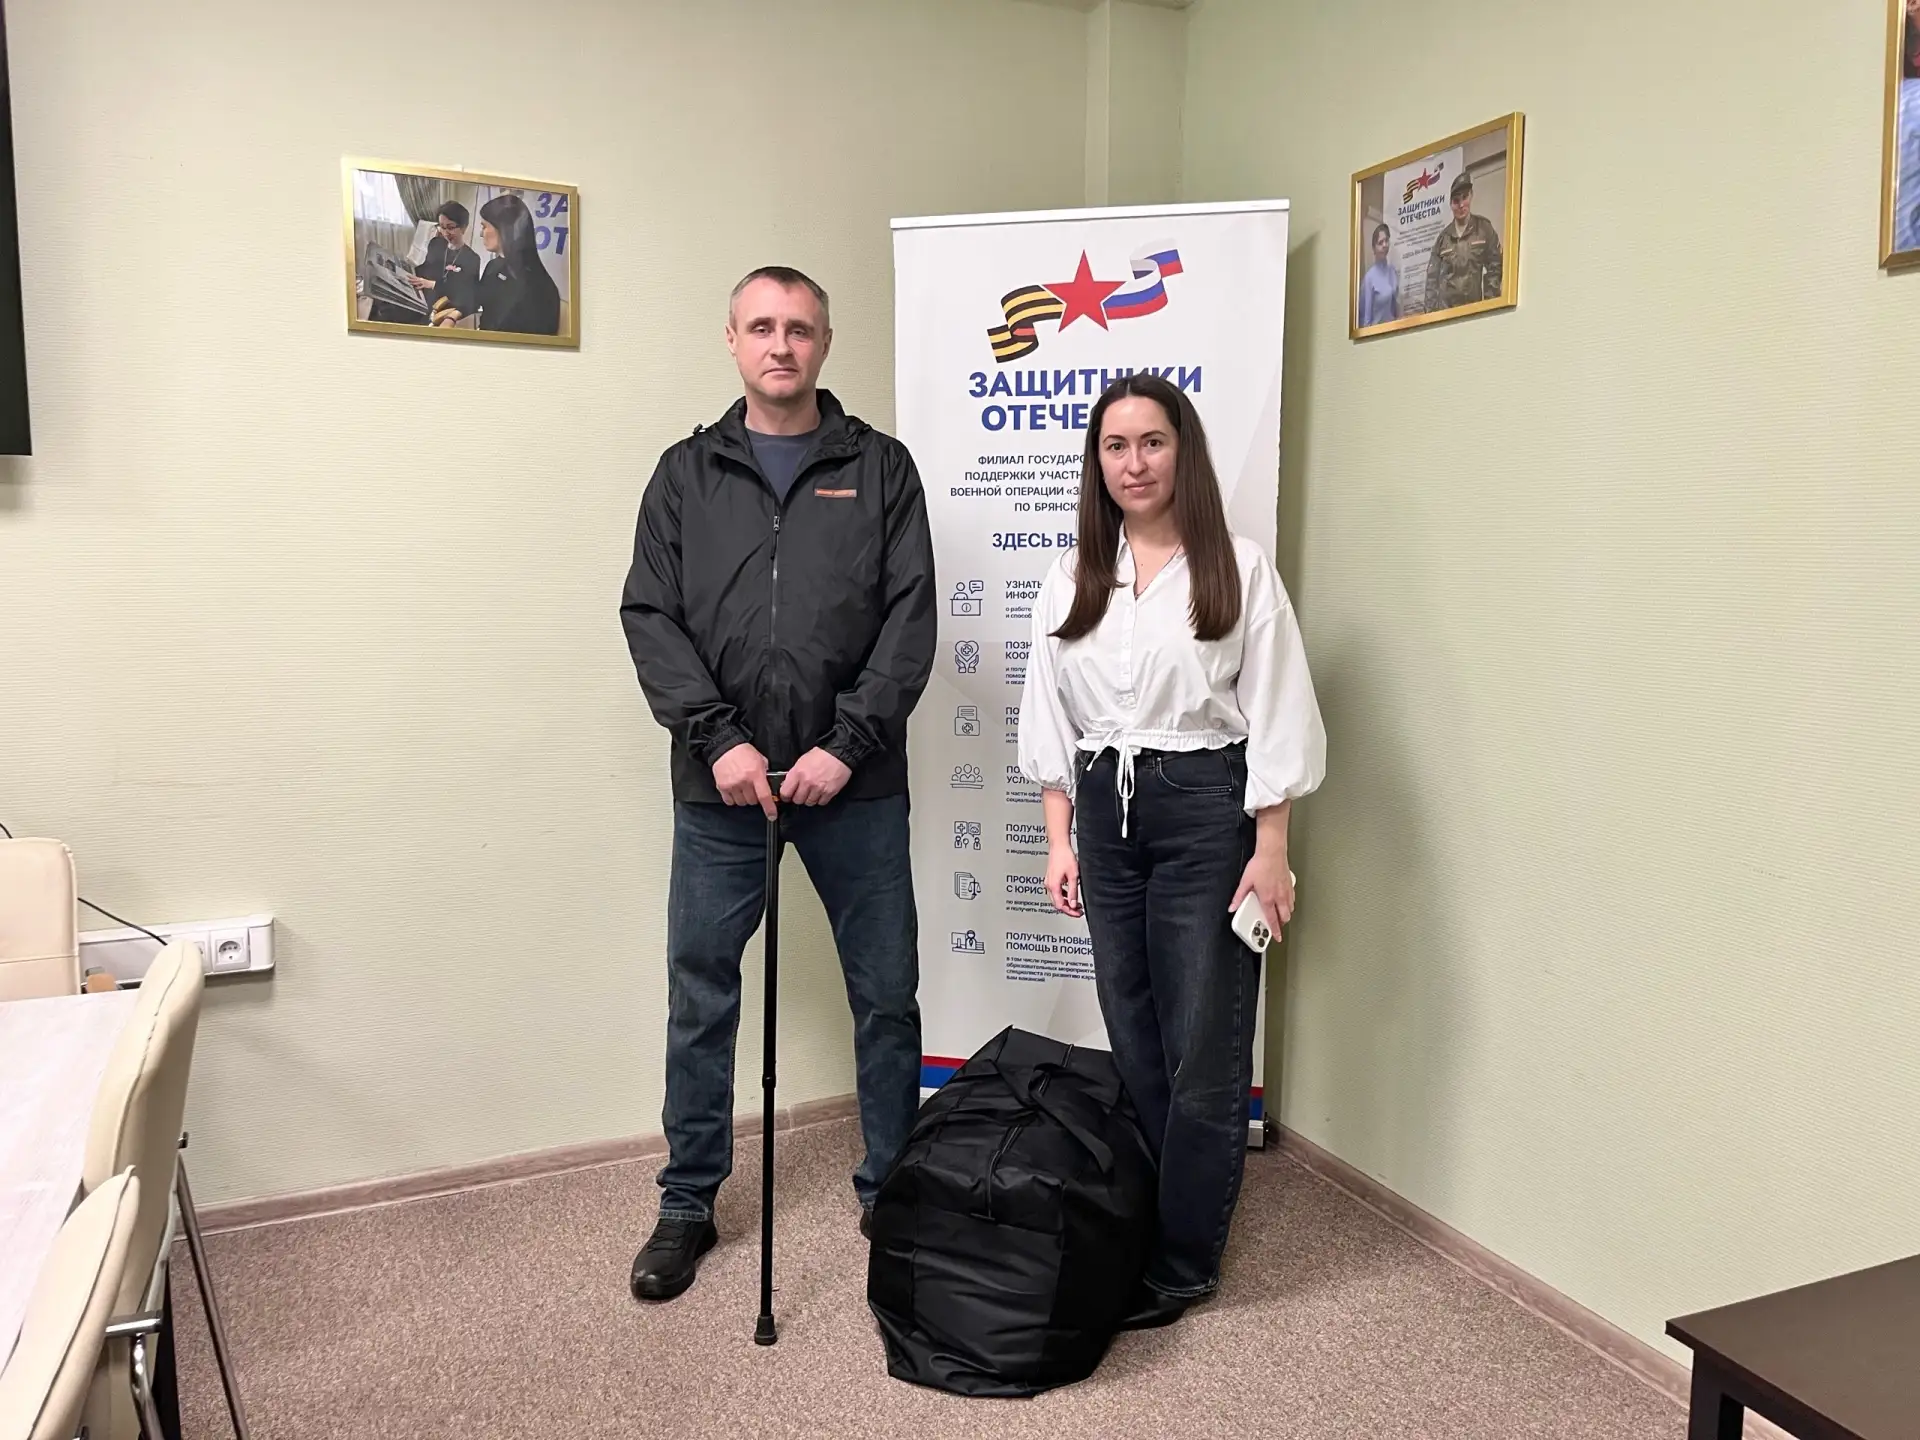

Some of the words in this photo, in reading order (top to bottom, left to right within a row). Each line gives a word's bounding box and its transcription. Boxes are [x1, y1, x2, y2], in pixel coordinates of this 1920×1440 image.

[535, 192, 568, 218] ЗА
[1398, 194, 1445, 216] ЗАЩИТНИКИ
[1400, 206, 1441, 225] ОТЕЧЕСТВА
[981, 403, 1088, 431] ОТЕЧЕ
[978, 455, 1024, 465] ФИЛИАЛ
[964, 471, 1036, 482] ПОДДЕРЖКИ
[950, 485, 1002, 497] ВОЕННОЙ
[1005, 486, 1064, 498] ОПЕРАЦИИ
[1014, 502, 1030, 512] ПО
[992, 532, 1053, 551] ЗДЕСЬ
[1005, 580, 1042, 589] УЗНАТЬ
[1006, 932, 1057, 943] ПОЛУЧИТЬ
[1059, 936, 1092, 945] НОВЫЕ
[1006, 942, 1050, 953] ПОМОЩЬ
[1052, 945, 1058, 953] В
